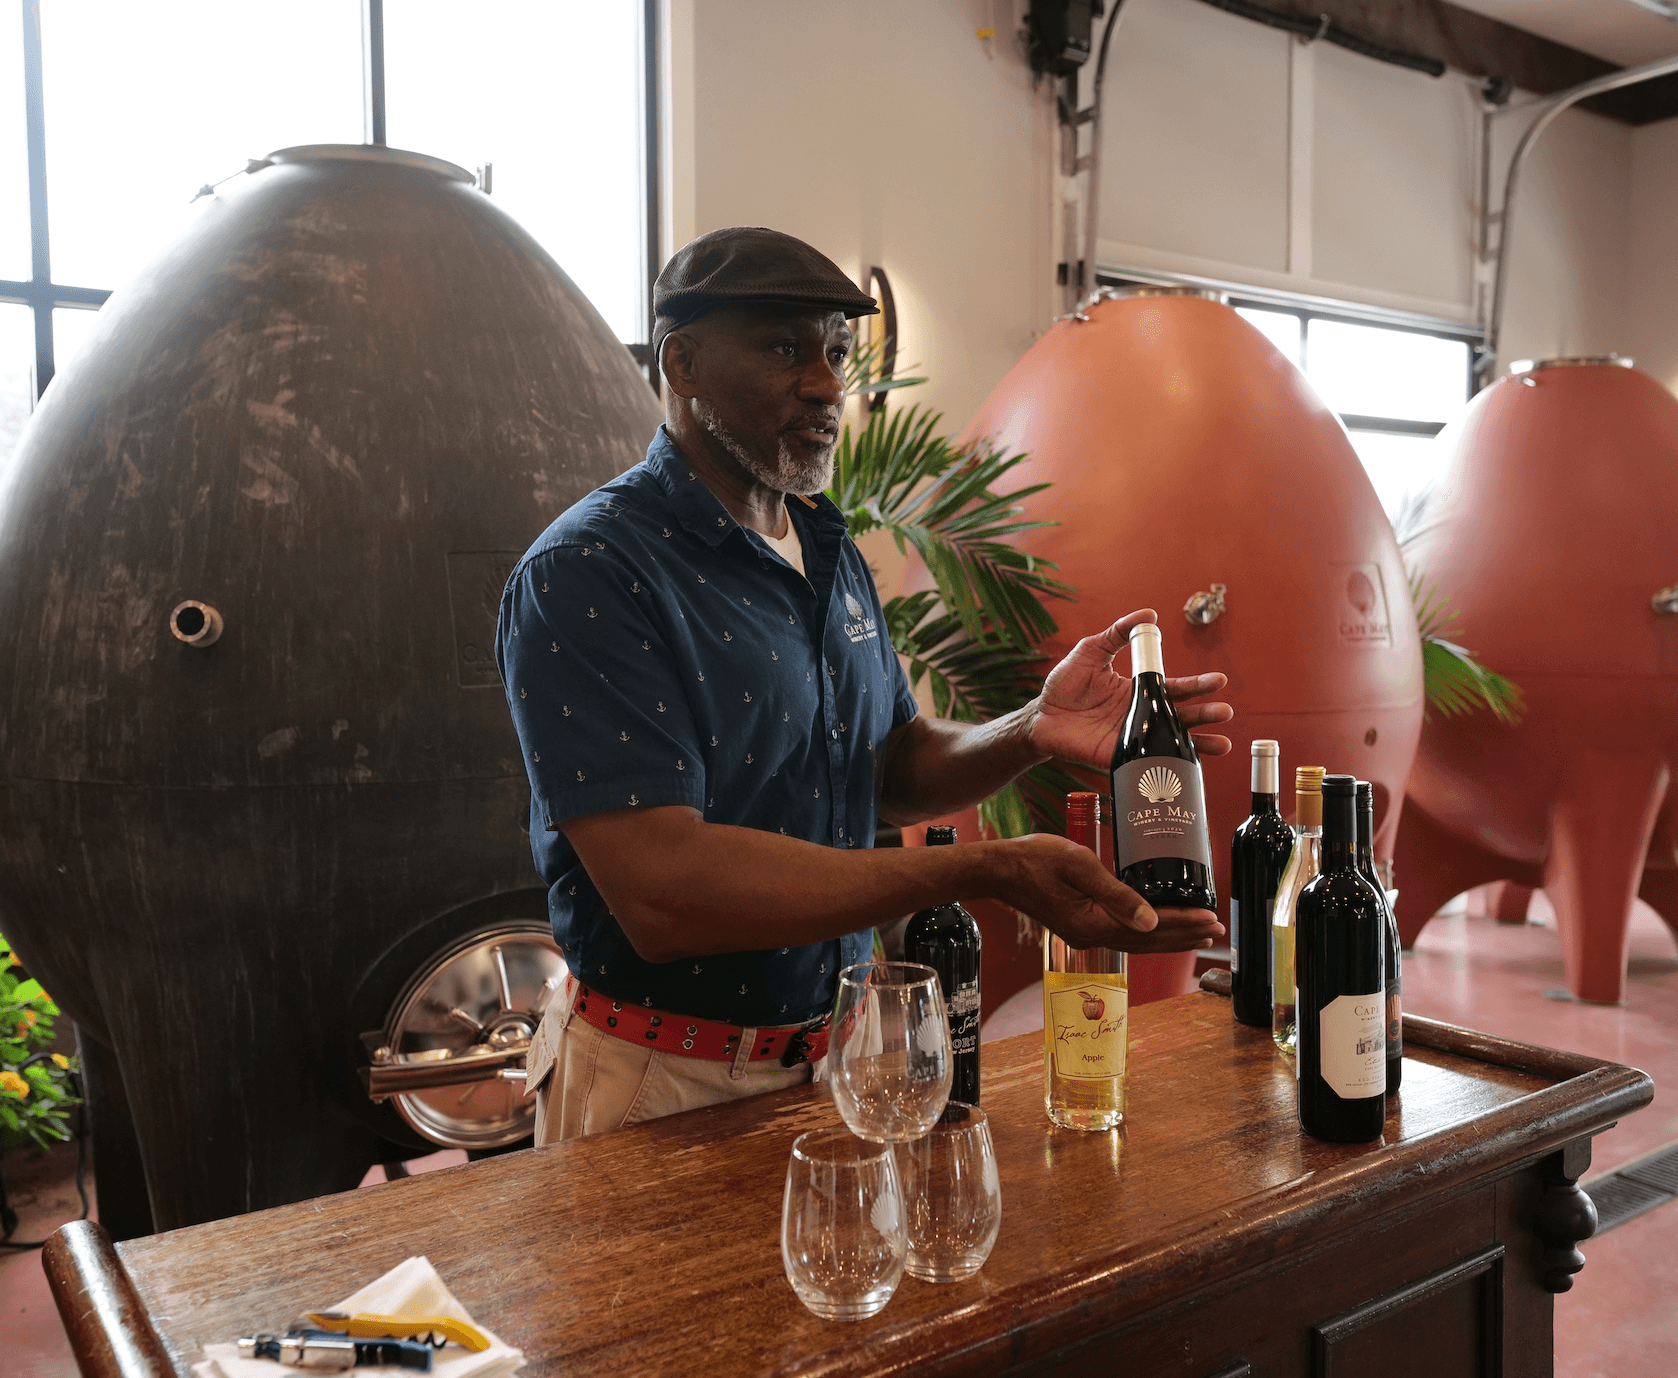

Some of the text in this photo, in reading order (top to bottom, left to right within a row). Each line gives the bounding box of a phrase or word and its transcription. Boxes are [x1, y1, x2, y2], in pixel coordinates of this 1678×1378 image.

[1127, 805, 1196, 822] CAPE MAY
[1133, 818, 1156, 826] WINERY
[1164, 817, 1193, 825] VINEYARD
[1057, 1014, 1126, 1045] Isaac Smith
[952, 1035, 977, 1050] ORT
[1082, 1054, 1104, 1063] Apple
